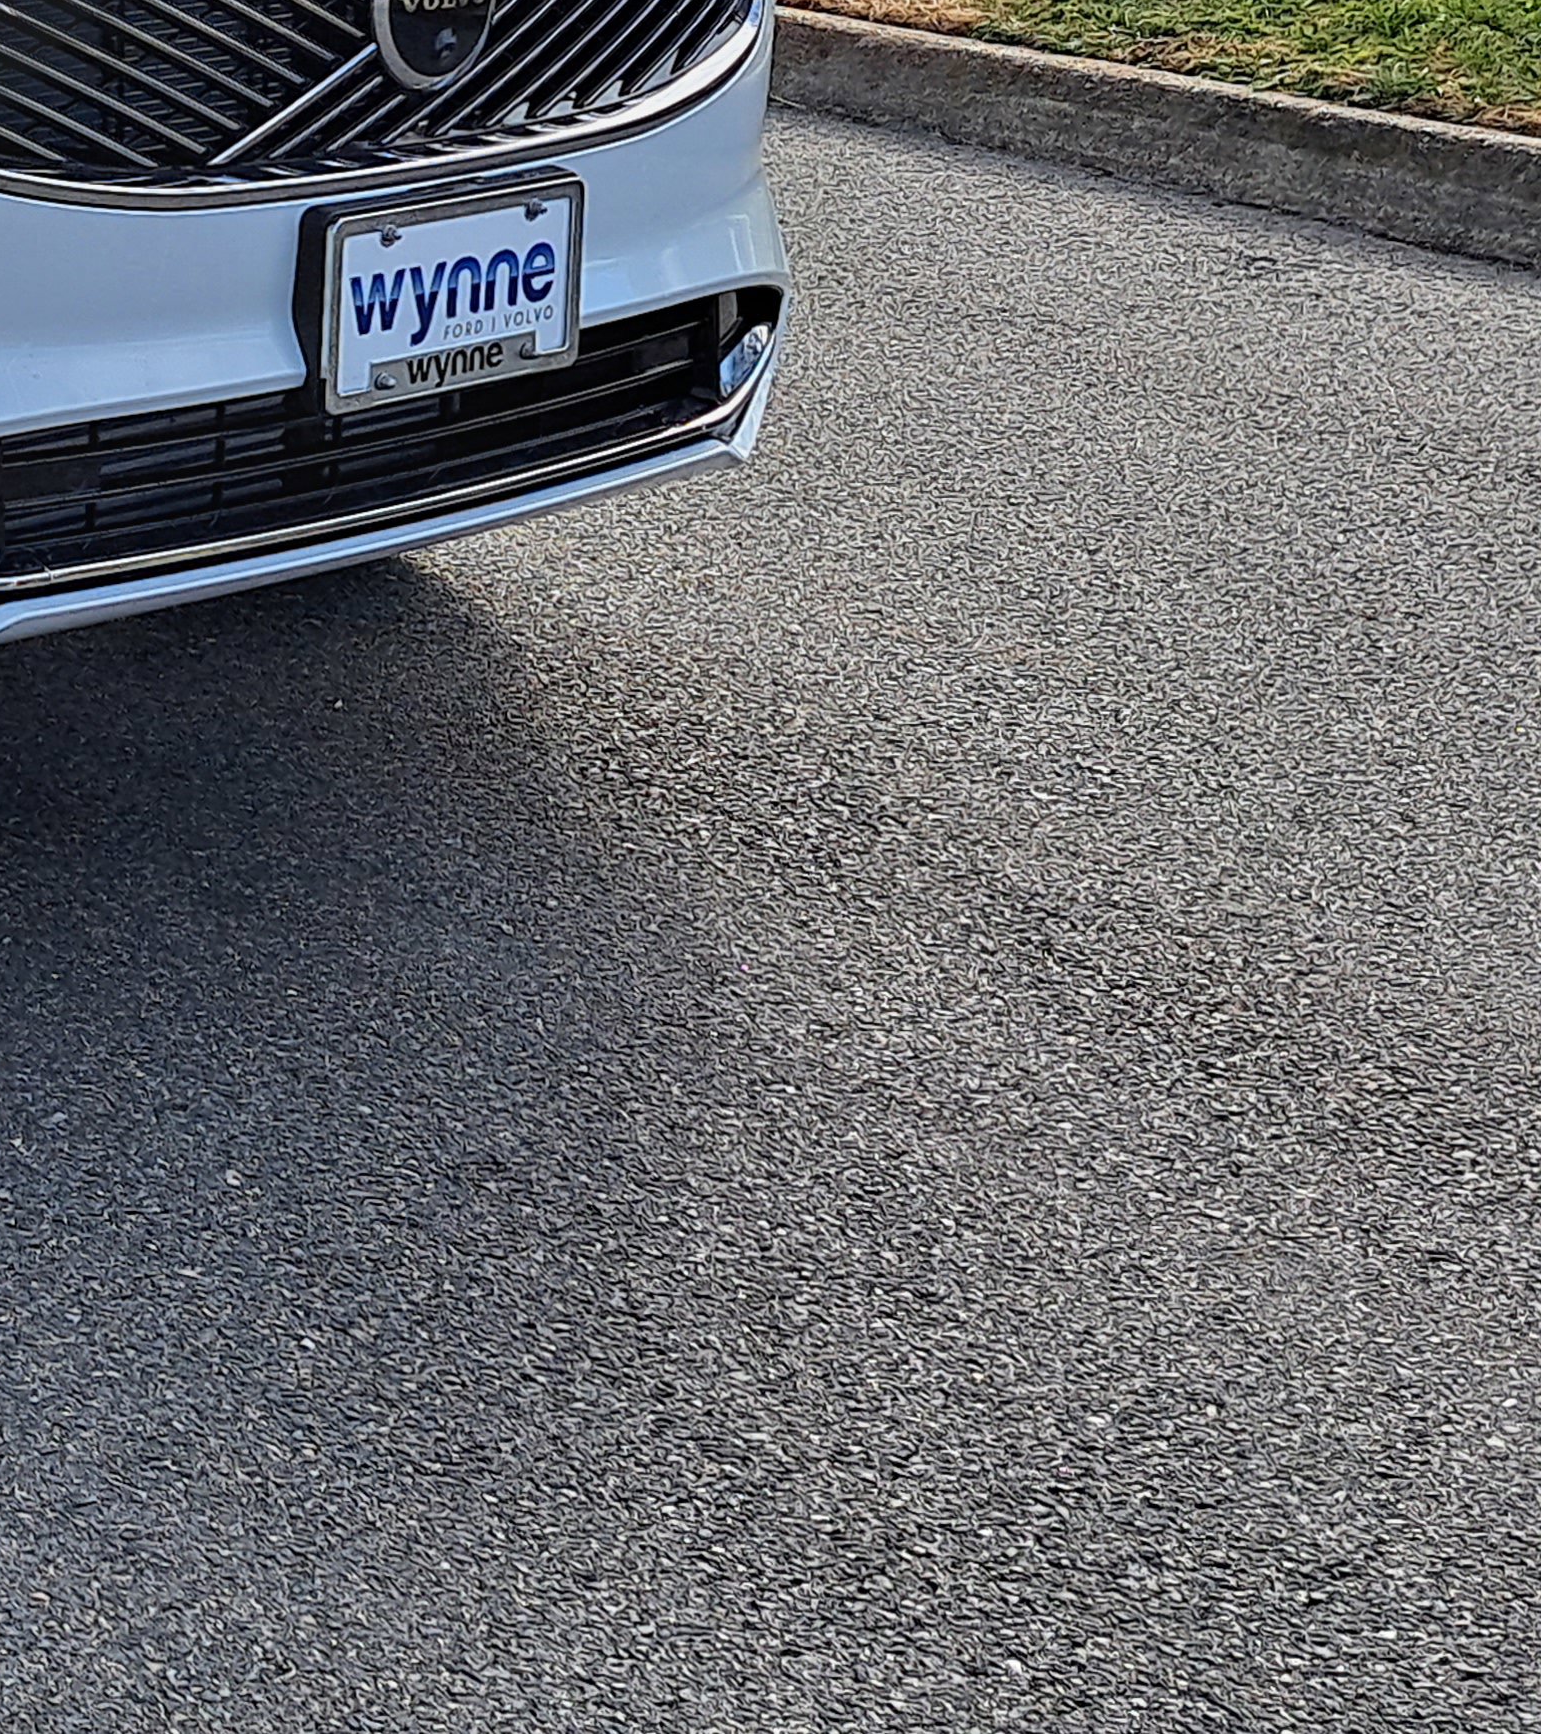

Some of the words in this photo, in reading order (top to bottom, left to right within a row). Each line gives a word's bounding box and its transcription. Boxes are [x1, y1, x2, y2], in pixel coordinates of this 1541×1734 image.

[349, 241, 556, 348] wynne
[442, 319, 484, 340] FORD
[503, 305, 555, 329] VOLVO
[406, 341, 505, 388] wynne
